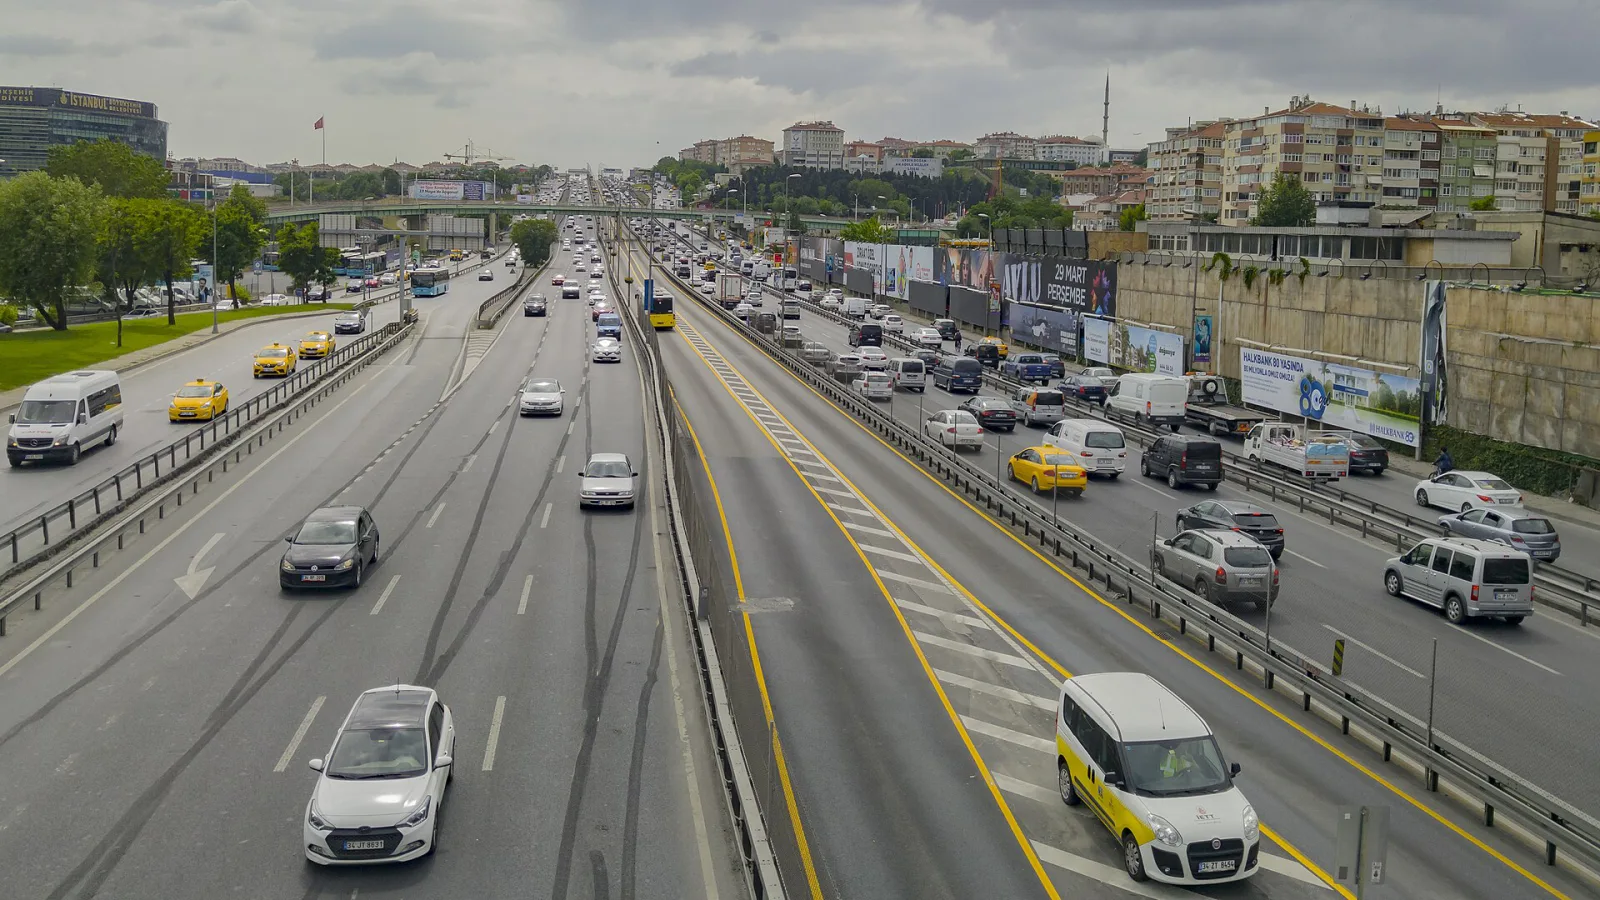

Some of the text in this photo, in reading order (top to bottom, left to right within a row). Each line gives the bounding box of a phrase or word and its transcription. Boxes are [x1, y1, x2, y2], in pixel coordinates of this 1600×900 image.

[70, 92, 108, 110] İSTANBUL
[1055, 264, 1087, 284] 29 MART
[1047, 284, 1086, 306] PERŞEMBE
[1243, 352, 1304, 373] HALKBANK 80 YAŞINDA
[1248, 364, 1268, 376] MİLYONLA
[1268, 369, 1279, 379] OMUZ
[1375, 424, 1405, 440] HALKBANK
